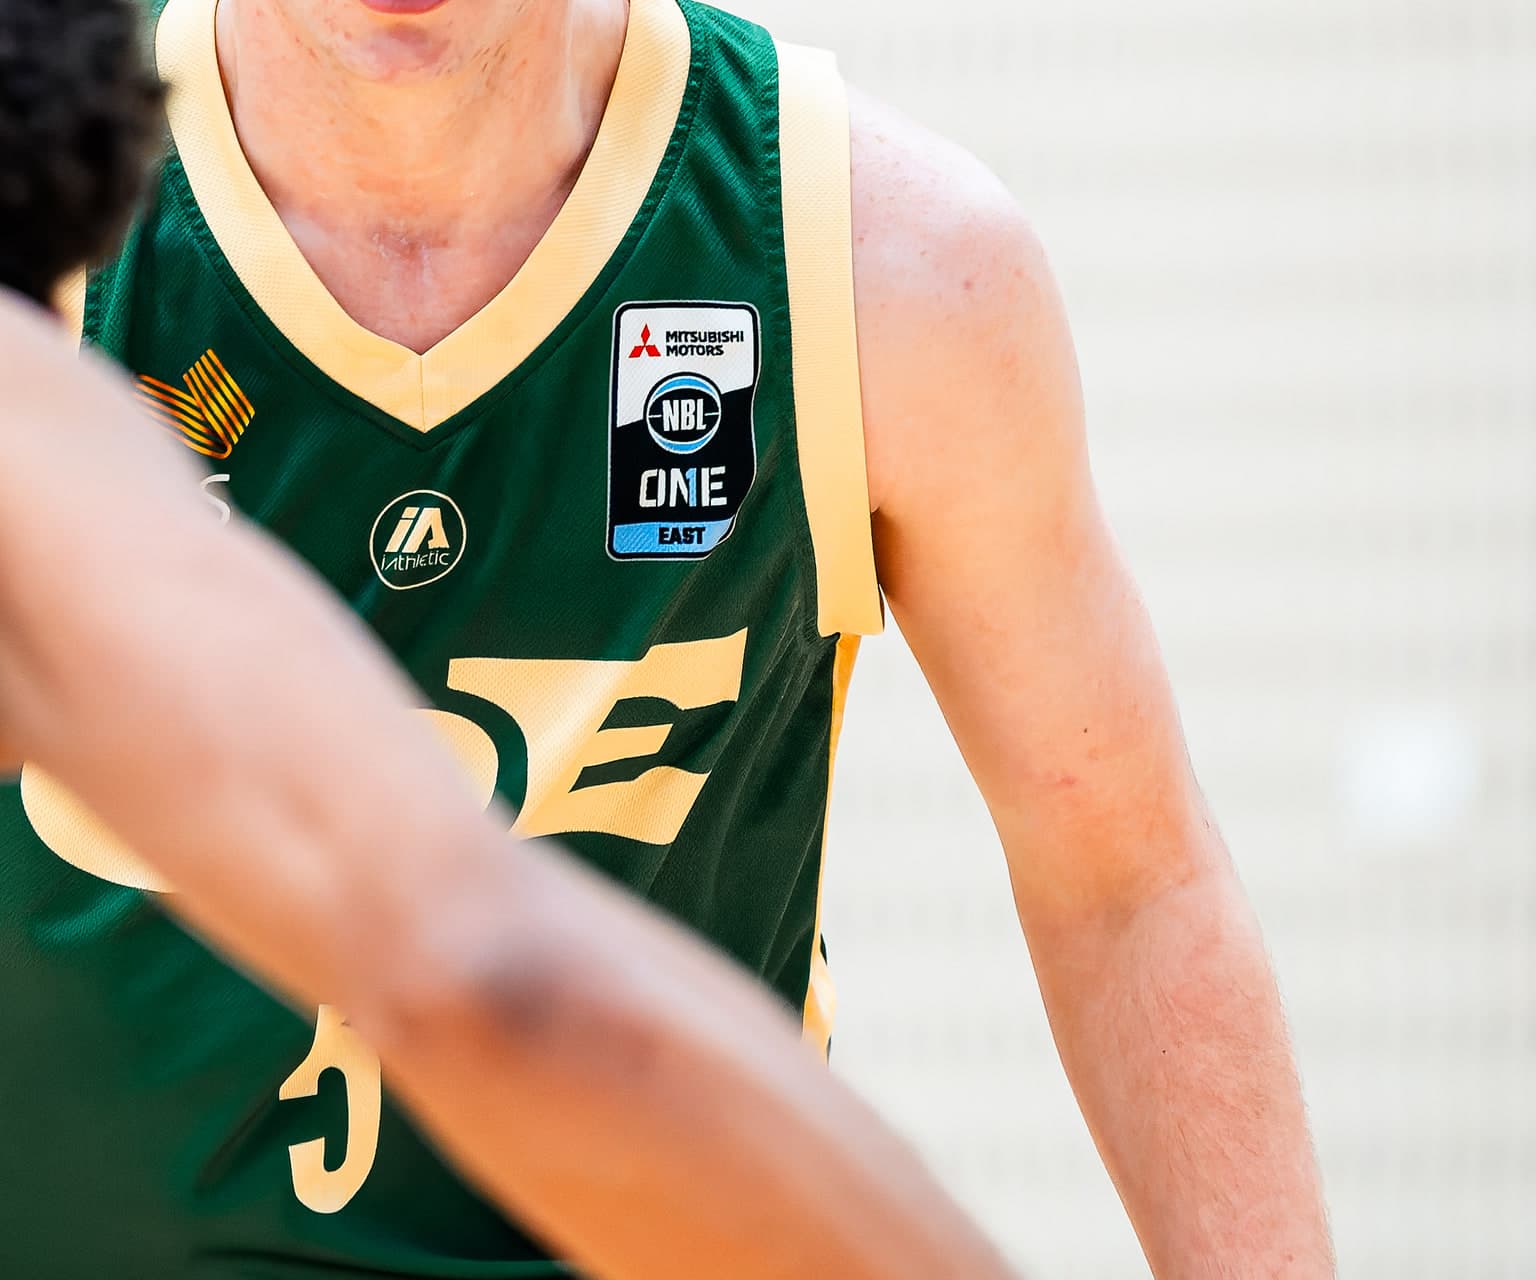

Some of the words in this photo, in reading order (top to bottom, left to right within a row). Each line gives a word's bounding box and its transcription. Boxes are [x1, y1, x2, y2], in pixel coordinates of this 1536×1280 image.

[665, 330, 744, 343] MITSUBISHI
[665, 344, 725, 357] MOTORS
[661, 398, 707, 432] NBL
[658, 526, 706, 545] EAST
